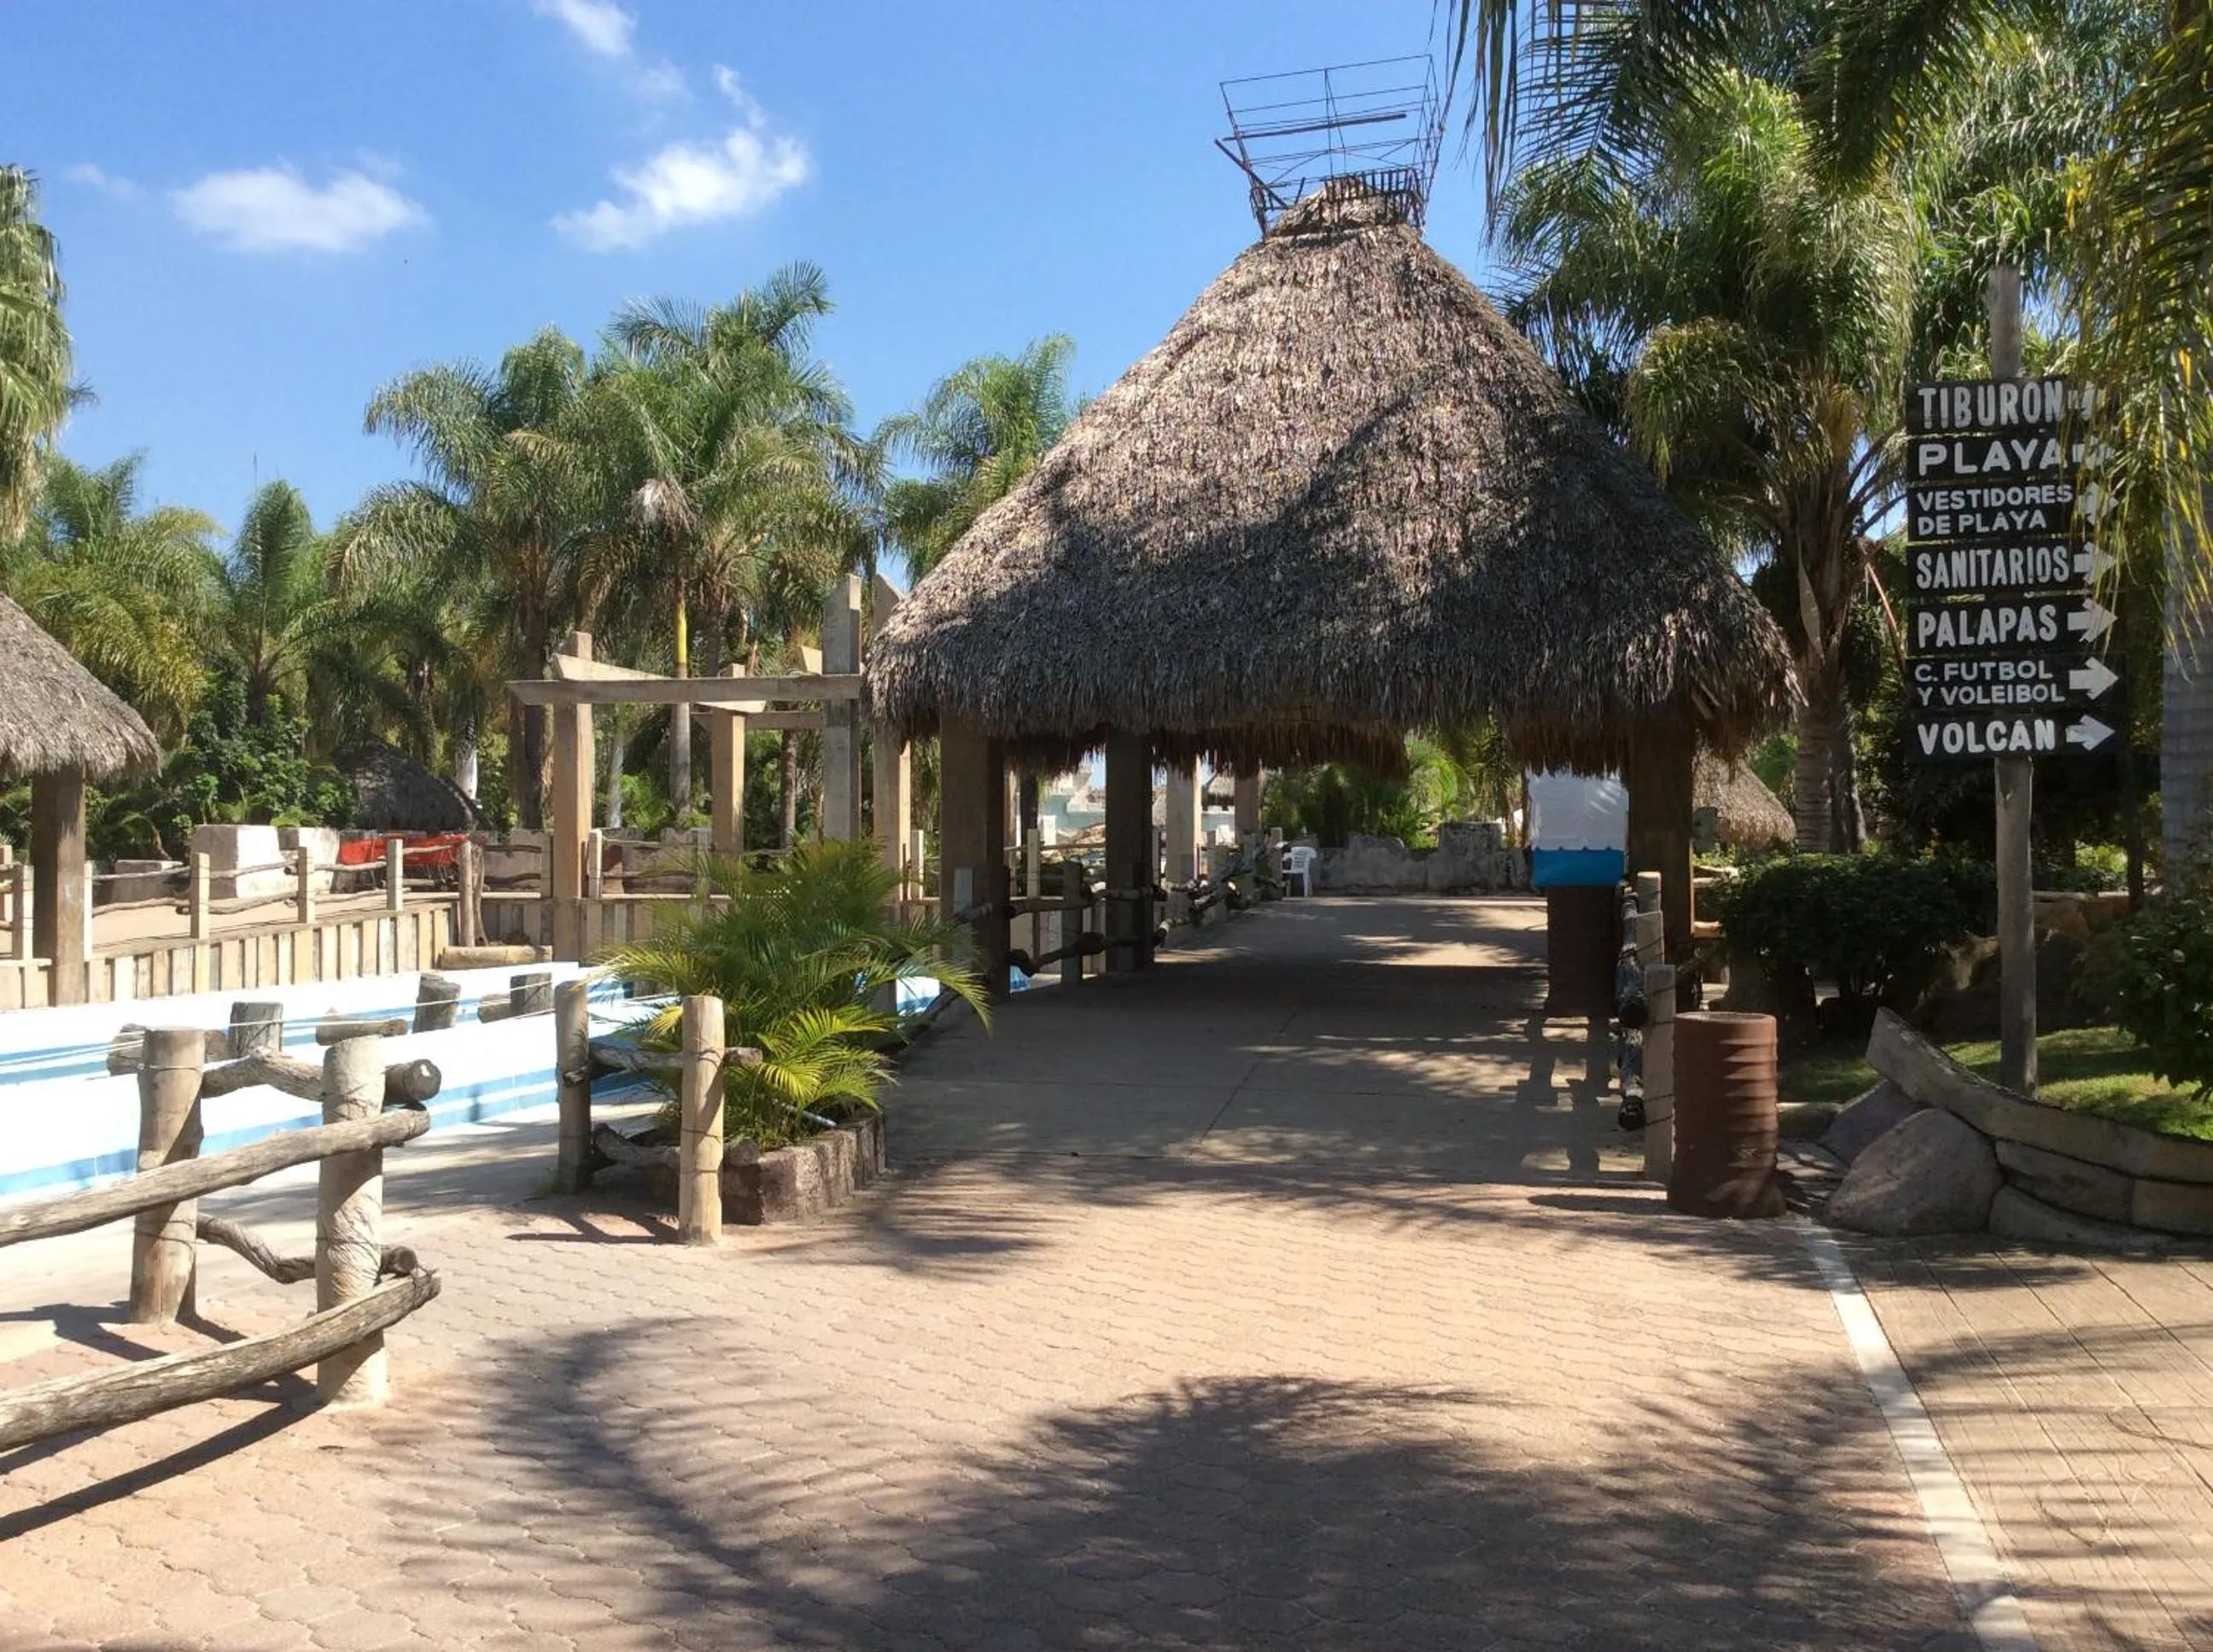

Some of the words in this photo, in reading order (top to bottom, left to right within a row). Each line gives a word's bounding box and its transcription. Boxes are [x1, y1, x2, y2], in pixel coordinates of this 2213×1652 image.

[1918, 381, 2063, 429] TIBURON
[1918, 438, 2068, 476] PLAYA
[1918, 484, 2073, 511] VESTIDORES
[1918, 516, 1950, 535] DE
[1959, 510, 2047, 533] PLAYA
[1916, 546, 2070, 589] SANITARIOS
[1918, 604, 2058, 648] PALAPAS
[1914, 663, 1938, 682] C.
[1944, 660, 2053, 681] FUTBOL
[1918, 686, 1933, 706] Y
[1941, 683, 2065, 706] VOLEIBOL
[1917, 720, 2056, 755] VOLCAN
